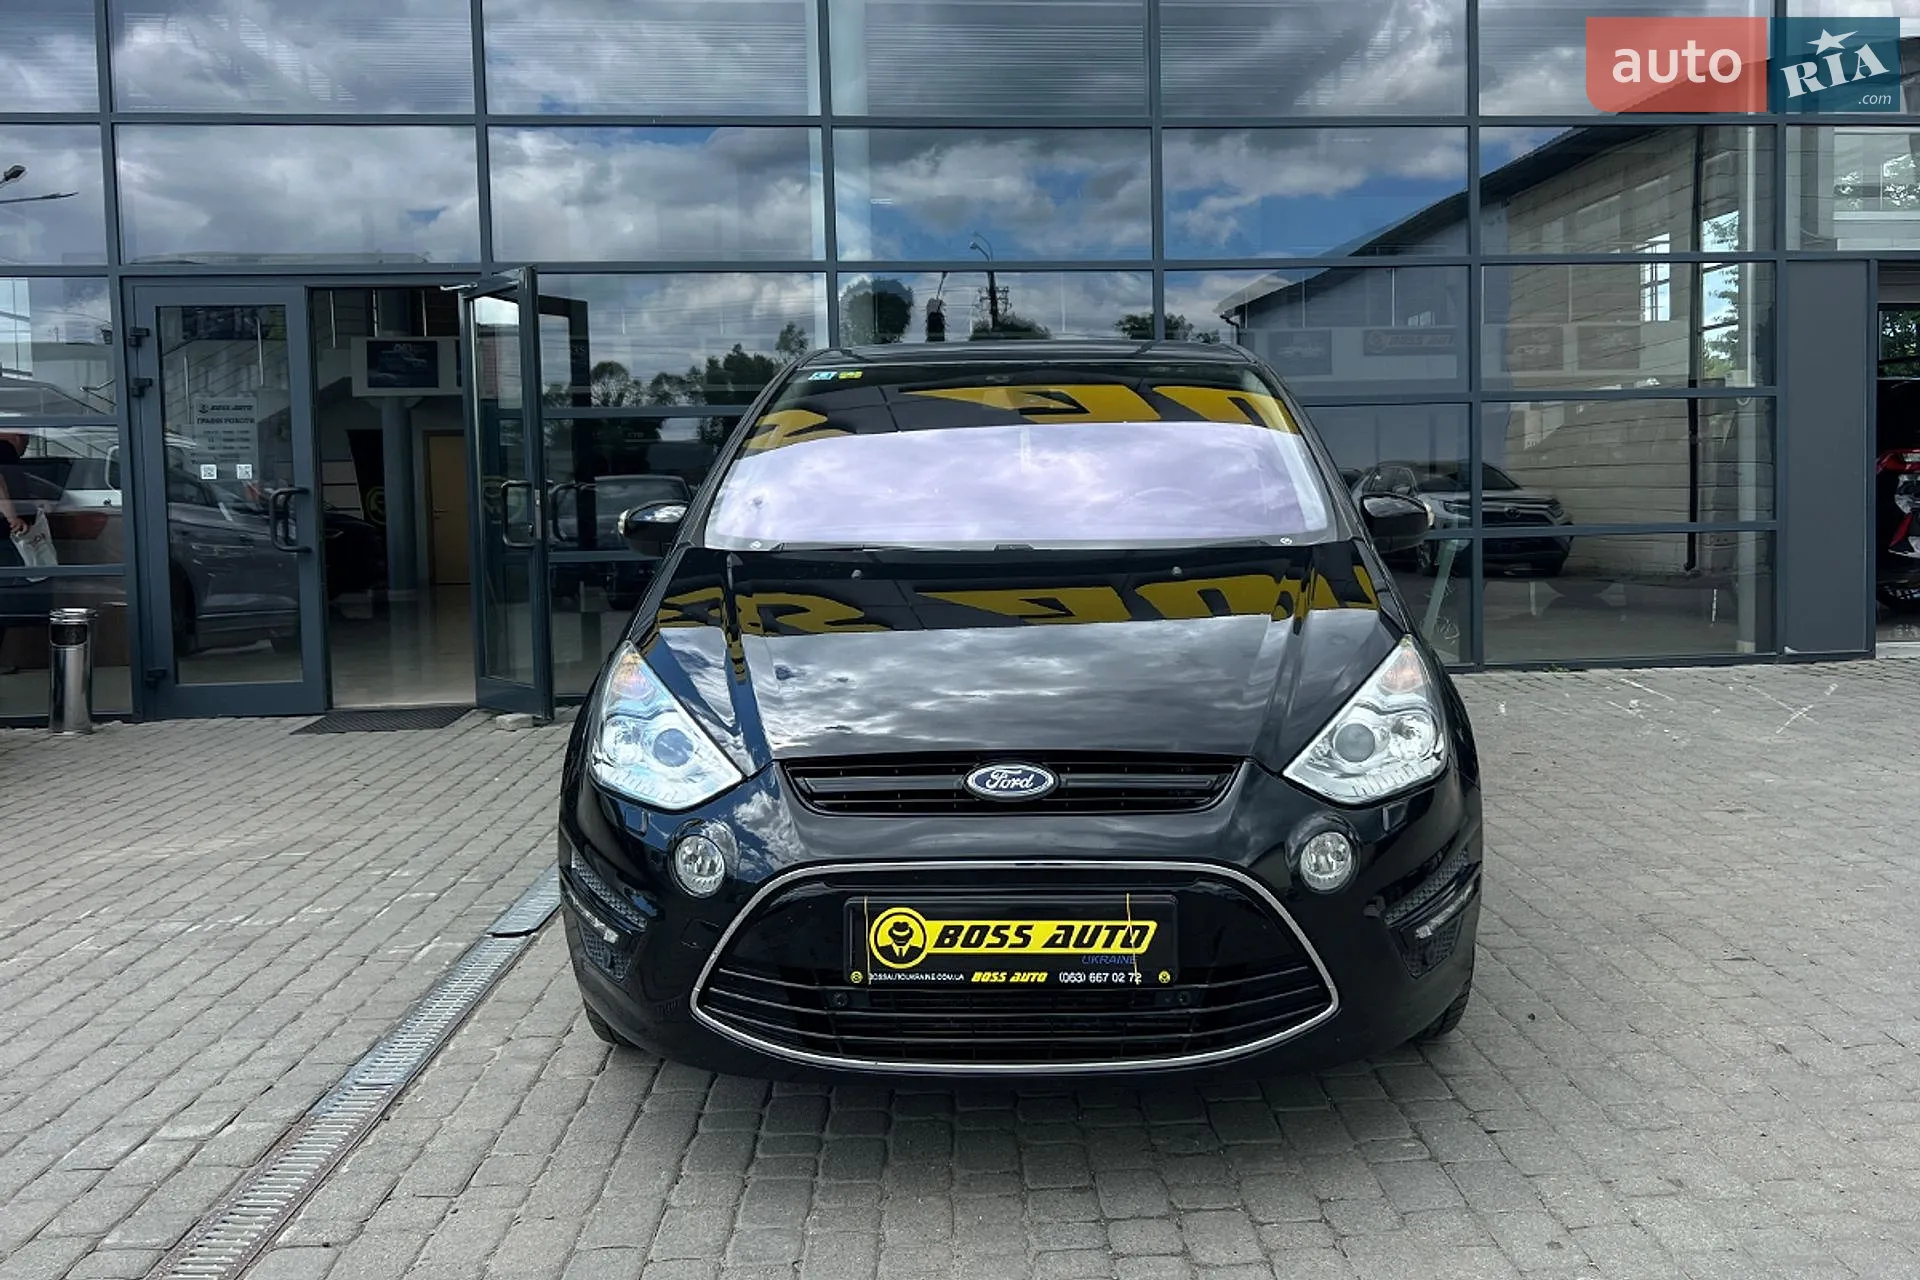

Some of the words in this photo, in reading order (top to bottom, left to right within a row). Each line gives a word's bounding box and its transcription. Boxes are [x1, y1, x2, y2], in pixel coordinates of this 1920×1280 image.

[985, 769, 1035, 789] Ford
[932, 924, 1035, 949] BOSS
[1041, 924, 1151, 949] AUTO
[1081, 955, 1138, 965] UKRAINE
[971, 971, 1008, 983] BOSS
[1009, 971, 1049, 983] AUTO
[1059, 971, 1086, 983] (063)
[1088, 972, 1110, 983] 667
[1111, 972, 1126, 983] 02
